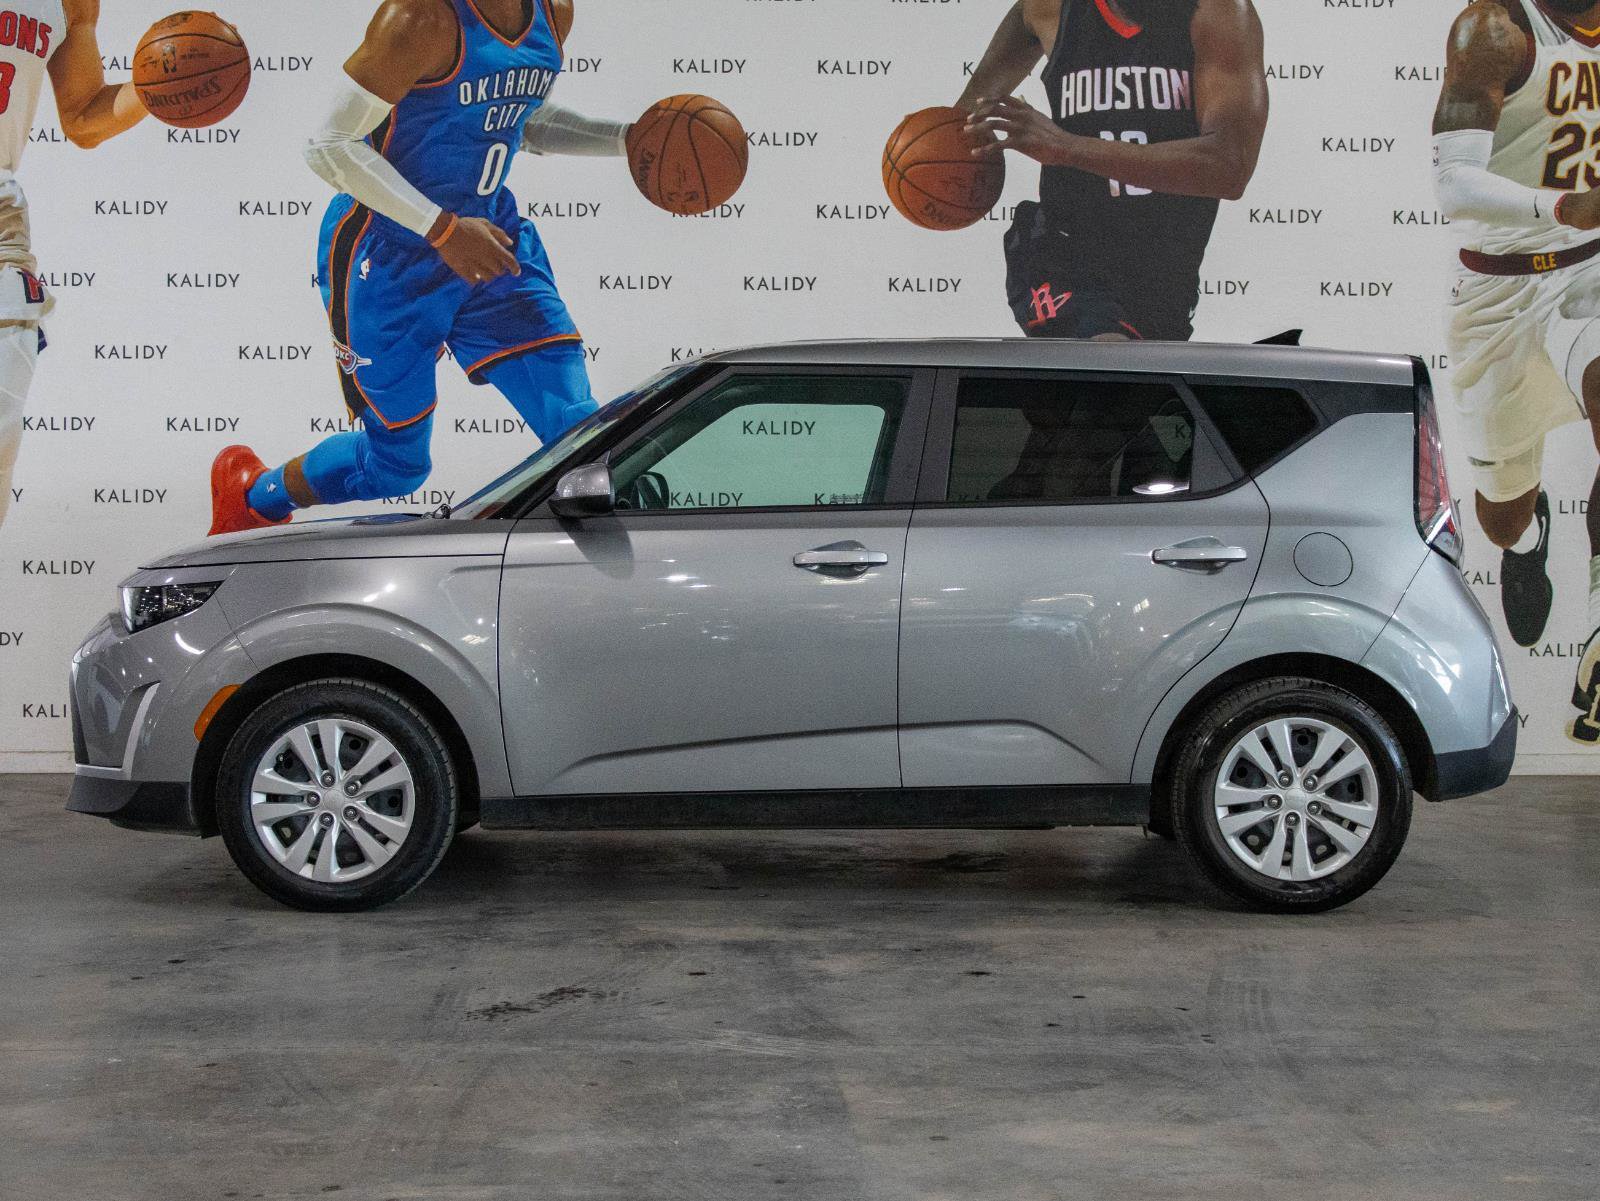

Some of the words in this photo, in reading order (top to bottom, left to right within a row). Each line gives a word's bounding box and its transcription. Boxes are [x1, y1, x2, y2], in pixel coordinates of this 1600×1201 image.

[253, 56, 313, 72] ALIDY
[674, 59, 746, 73] KALIDY
[818, 60, 891, 75] KALIDY
[1265, 65, 1325, 80] ALIDY
[1395, 66, 1448, 81] KALI
[459, 69, 553, 106] OKLAHOM
[1060, 66, 1192, 118] HOUSTON
[484, 103, 527, 131] CITY
[168, 128, 240, 144] KALIDY
[747, 131, 818, 147] KALIDY
[1323, 138, 1394, 152] KALIDY
[477, 143, 510, 196] 0
[96, 201, 167, 215] KALIDY
[240, 201, 312, 215] KALIDY
[528, 203, 601, 218] KALIDY
[817, 205, 890, 220] KALIDY
[1250, 209, 1322, 223] KALIDY
[1393, 210, 1451, 225] KALID
[1532, 252, 1557, 272] CLE
[39, 272, 96, 287] ALIDY
[167, 273, 239, 287] KALIDY
[600, 276, 672, 289] KALIDY
[744, 276, 816, 291] KALIDY
[889, 278, 961, 292] KALIDY
[1198, 280, 1250, 295] LIDY
[1321, 282, 1392, 296] KALIDY
[95, 345, 167, 359] KALIDY
[239, 346, 311, 360] KALIDY
[23, 416, 95, 431] KALIDY
[167, 417, 239, 431] KALIDY
[310, 417, 363, 432] KALI
[455, 418, 528, 433] KALIDY
[743, 421, 815, 435] KALIDY
[95, 489, 167, 503] KALIDY
[670, 492, 743, 507] KALIDY
[23, 560, 95, 574] KALIDY
[23, 703, 67, 719] KALI
